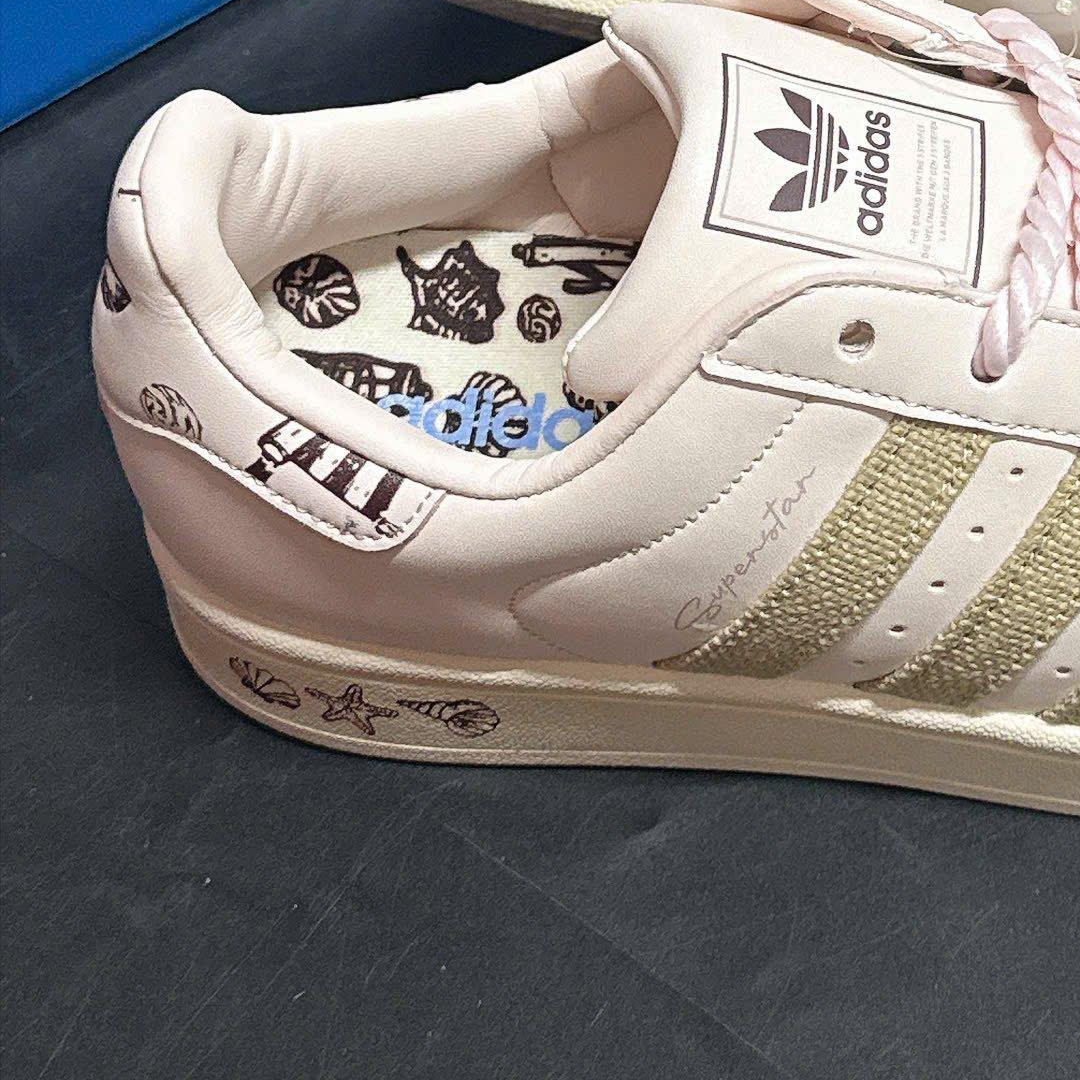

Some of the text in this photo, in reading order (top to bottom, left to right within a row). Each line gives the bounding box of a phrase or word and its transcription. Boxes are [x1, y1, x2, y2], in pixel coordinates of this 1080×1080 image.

[854, 110, 891, 236] adidas
[914, 176, 923, 195] WITH
[912, 197, 922, 226] BRAND
[923, 191, 936, 242] WELTMARKE
[909, 228, 919, 245] THE
[939, 230, 947, 242] LA
[921, 244, 930, 259] DIE
[377, 387, 597, 452] adida
[674, 468, 815, 631] Superstar
